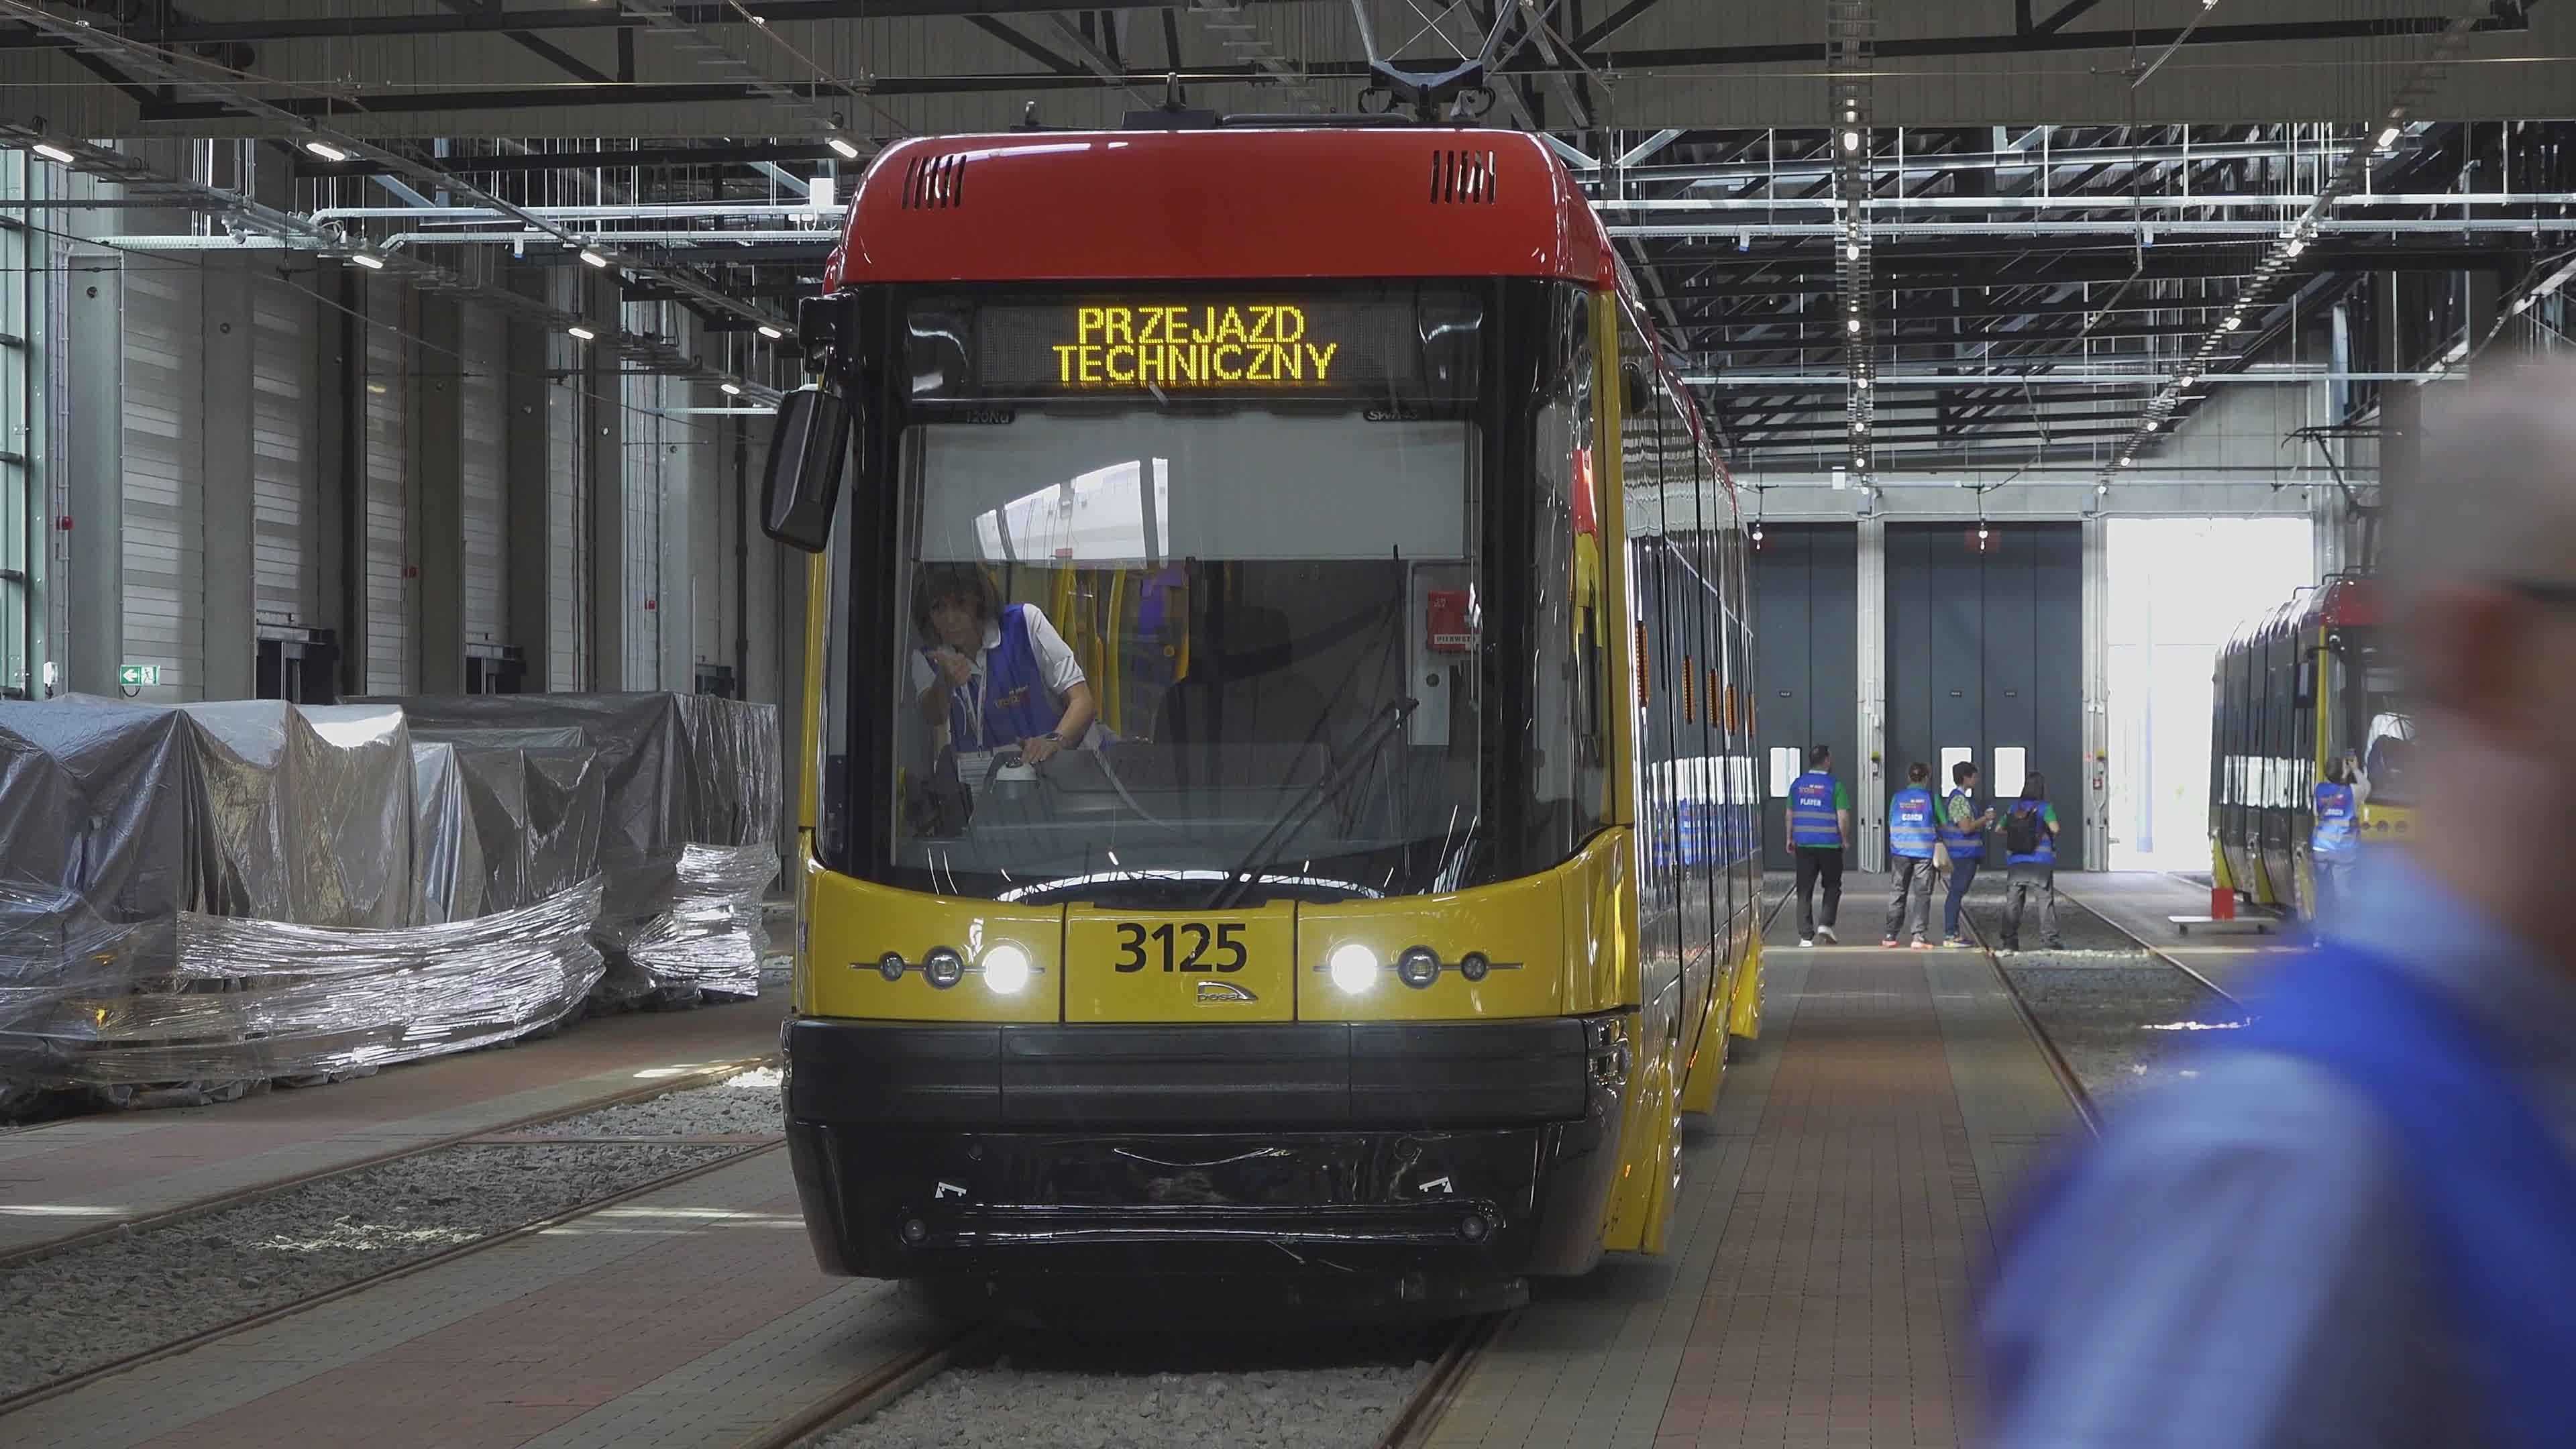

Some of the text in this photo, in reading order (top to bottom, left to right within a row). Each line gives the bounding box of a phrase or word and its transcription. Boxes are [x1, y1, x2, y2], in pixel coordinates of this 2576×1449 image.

[1079, 306, 1304, 344] PRZEJAZD
[1053, 343, 1337, 381] TECHNICZNY
[1115, 922, 1247, 972] 3125
